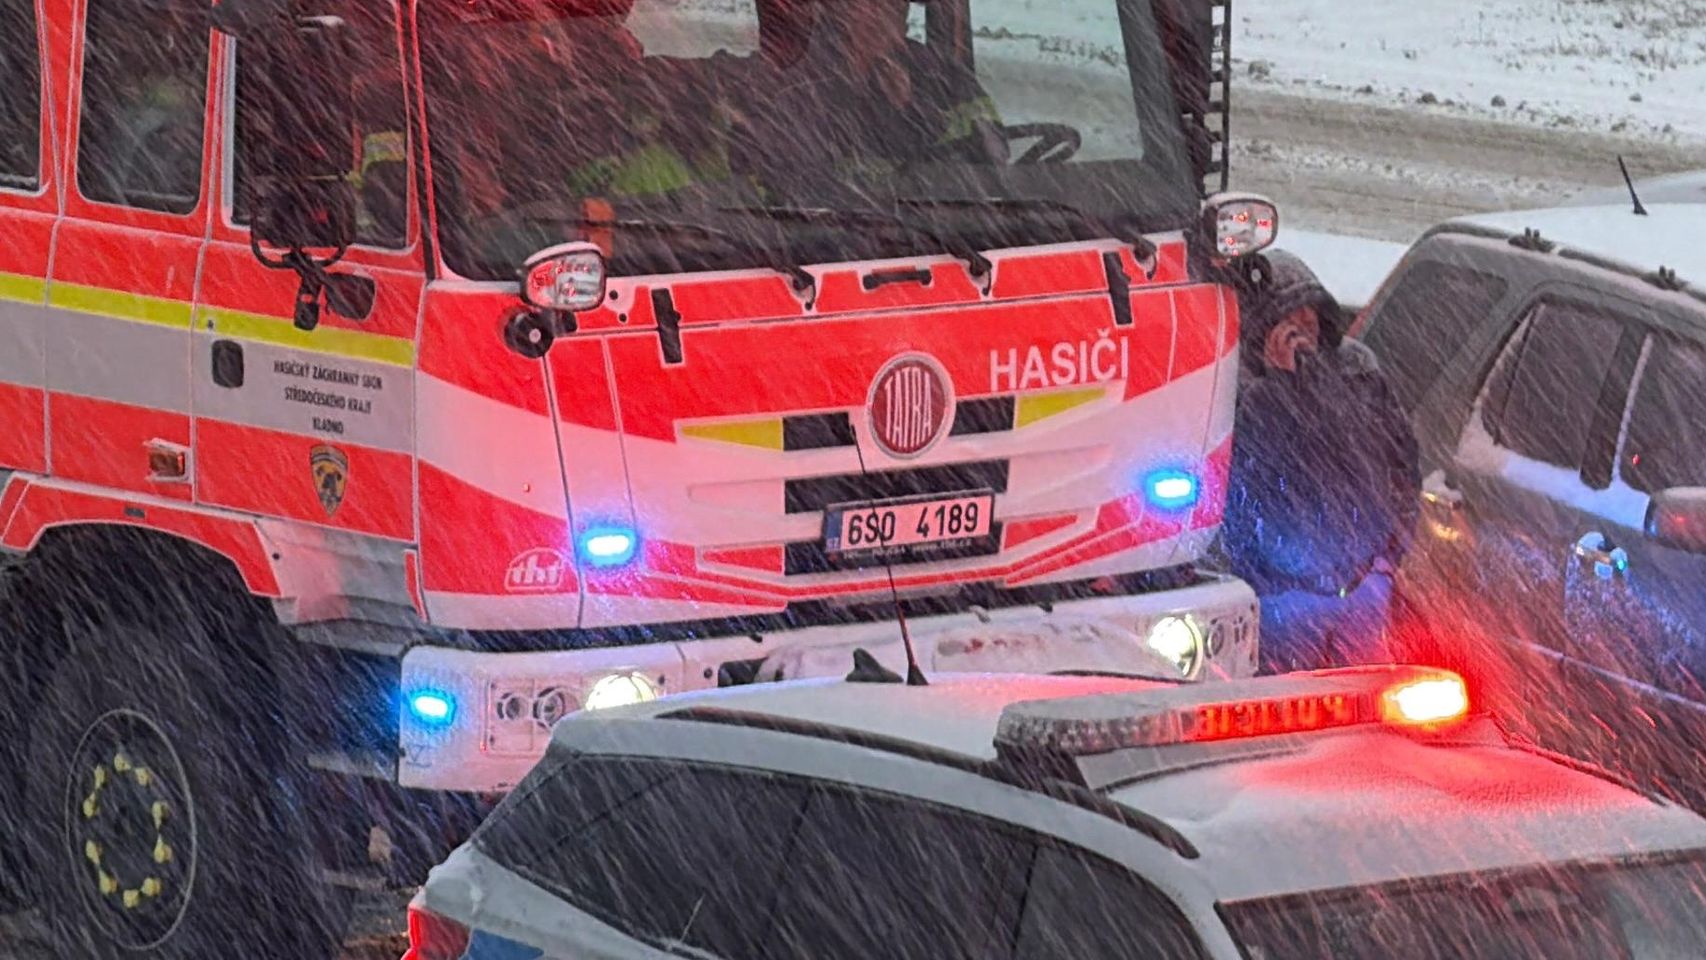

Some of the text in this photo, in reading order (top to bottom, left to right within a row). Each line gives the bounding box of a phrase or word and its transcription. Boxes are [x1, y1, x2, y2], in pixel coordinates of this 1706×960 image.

[990, 329, 1128, 390] HASIČI
[885, 367, 932, 449] TATRA
[916, 502, 978, 537] 4189
